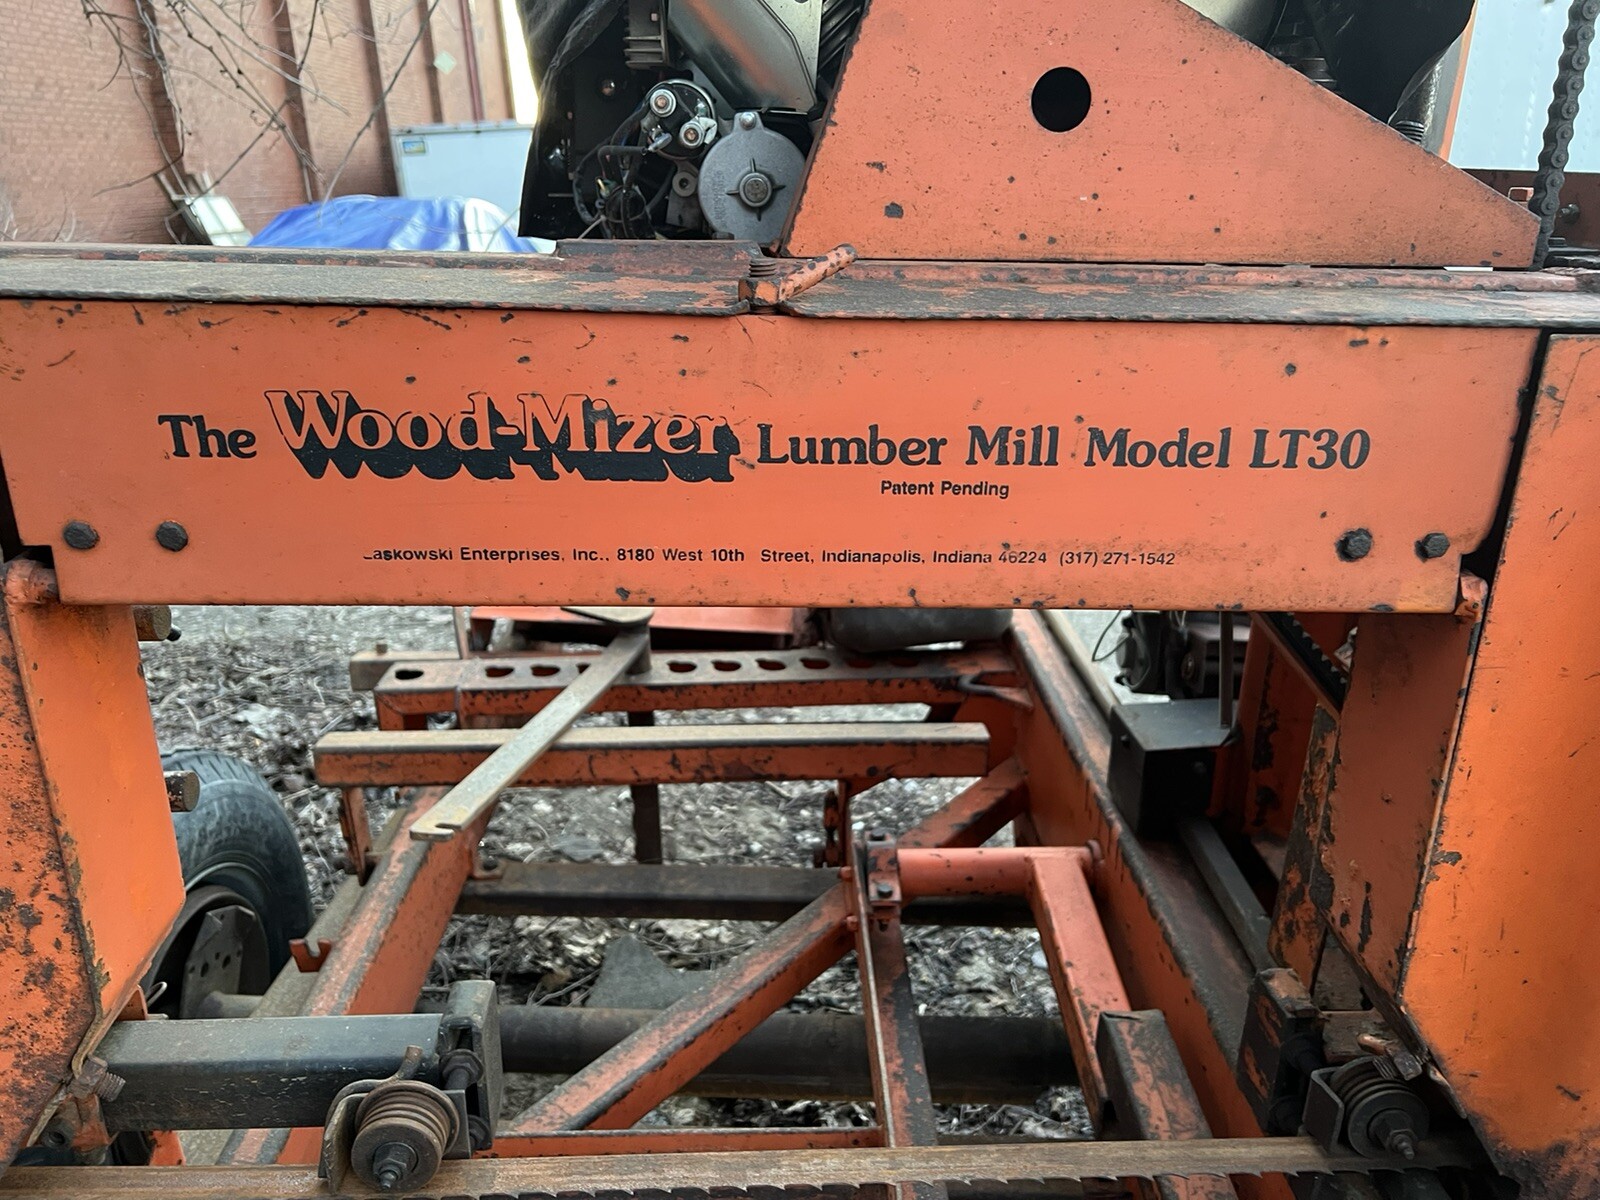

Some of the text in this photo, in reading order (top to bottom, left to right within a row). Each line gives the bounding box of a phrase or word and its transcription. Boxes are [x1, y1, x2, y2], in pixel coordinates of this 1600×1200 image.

[157, 390, 1370, 482] The Wood-Mizer Lumber Mill Model LT30
[881, 480, 1009, 499] Patent Pending
[363, 547, 453, 561] askowski
[617, 548, 654, 561] 8180
[663, 549, 702, 561] West
[711, 549, 744, 561] 10th
[761, 549, 814, 563] Street,
[822, 550, 924, 565] Indianapolis,
[933, 551, 992, 563] Indiana
[999, 550, 1046, 564] 46224
[1060, 552, 1098, 567] (317)
[1103, 552, 1175, 565] 271-1542
